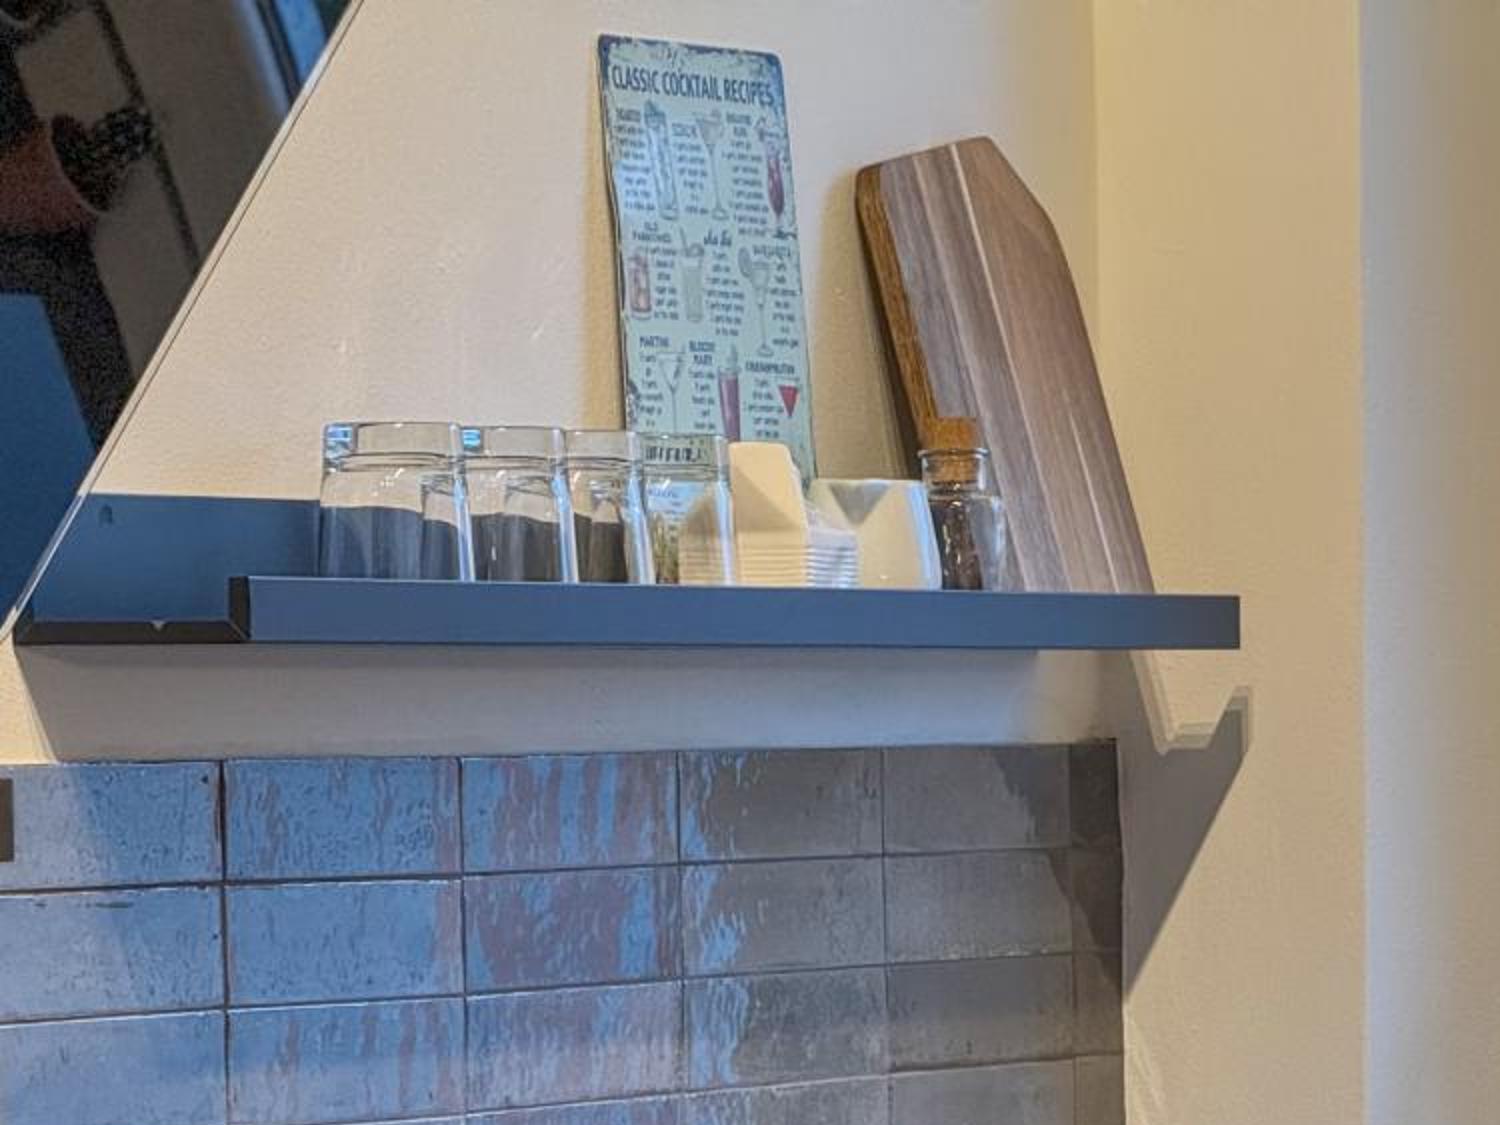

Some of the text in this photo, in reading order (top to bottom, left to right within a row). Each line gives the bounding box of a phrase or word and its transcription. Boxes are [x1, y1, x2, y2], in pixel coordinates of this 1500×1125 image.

[611, 65, 775, 106] CLASSIC COCKTAIL RECIPES
